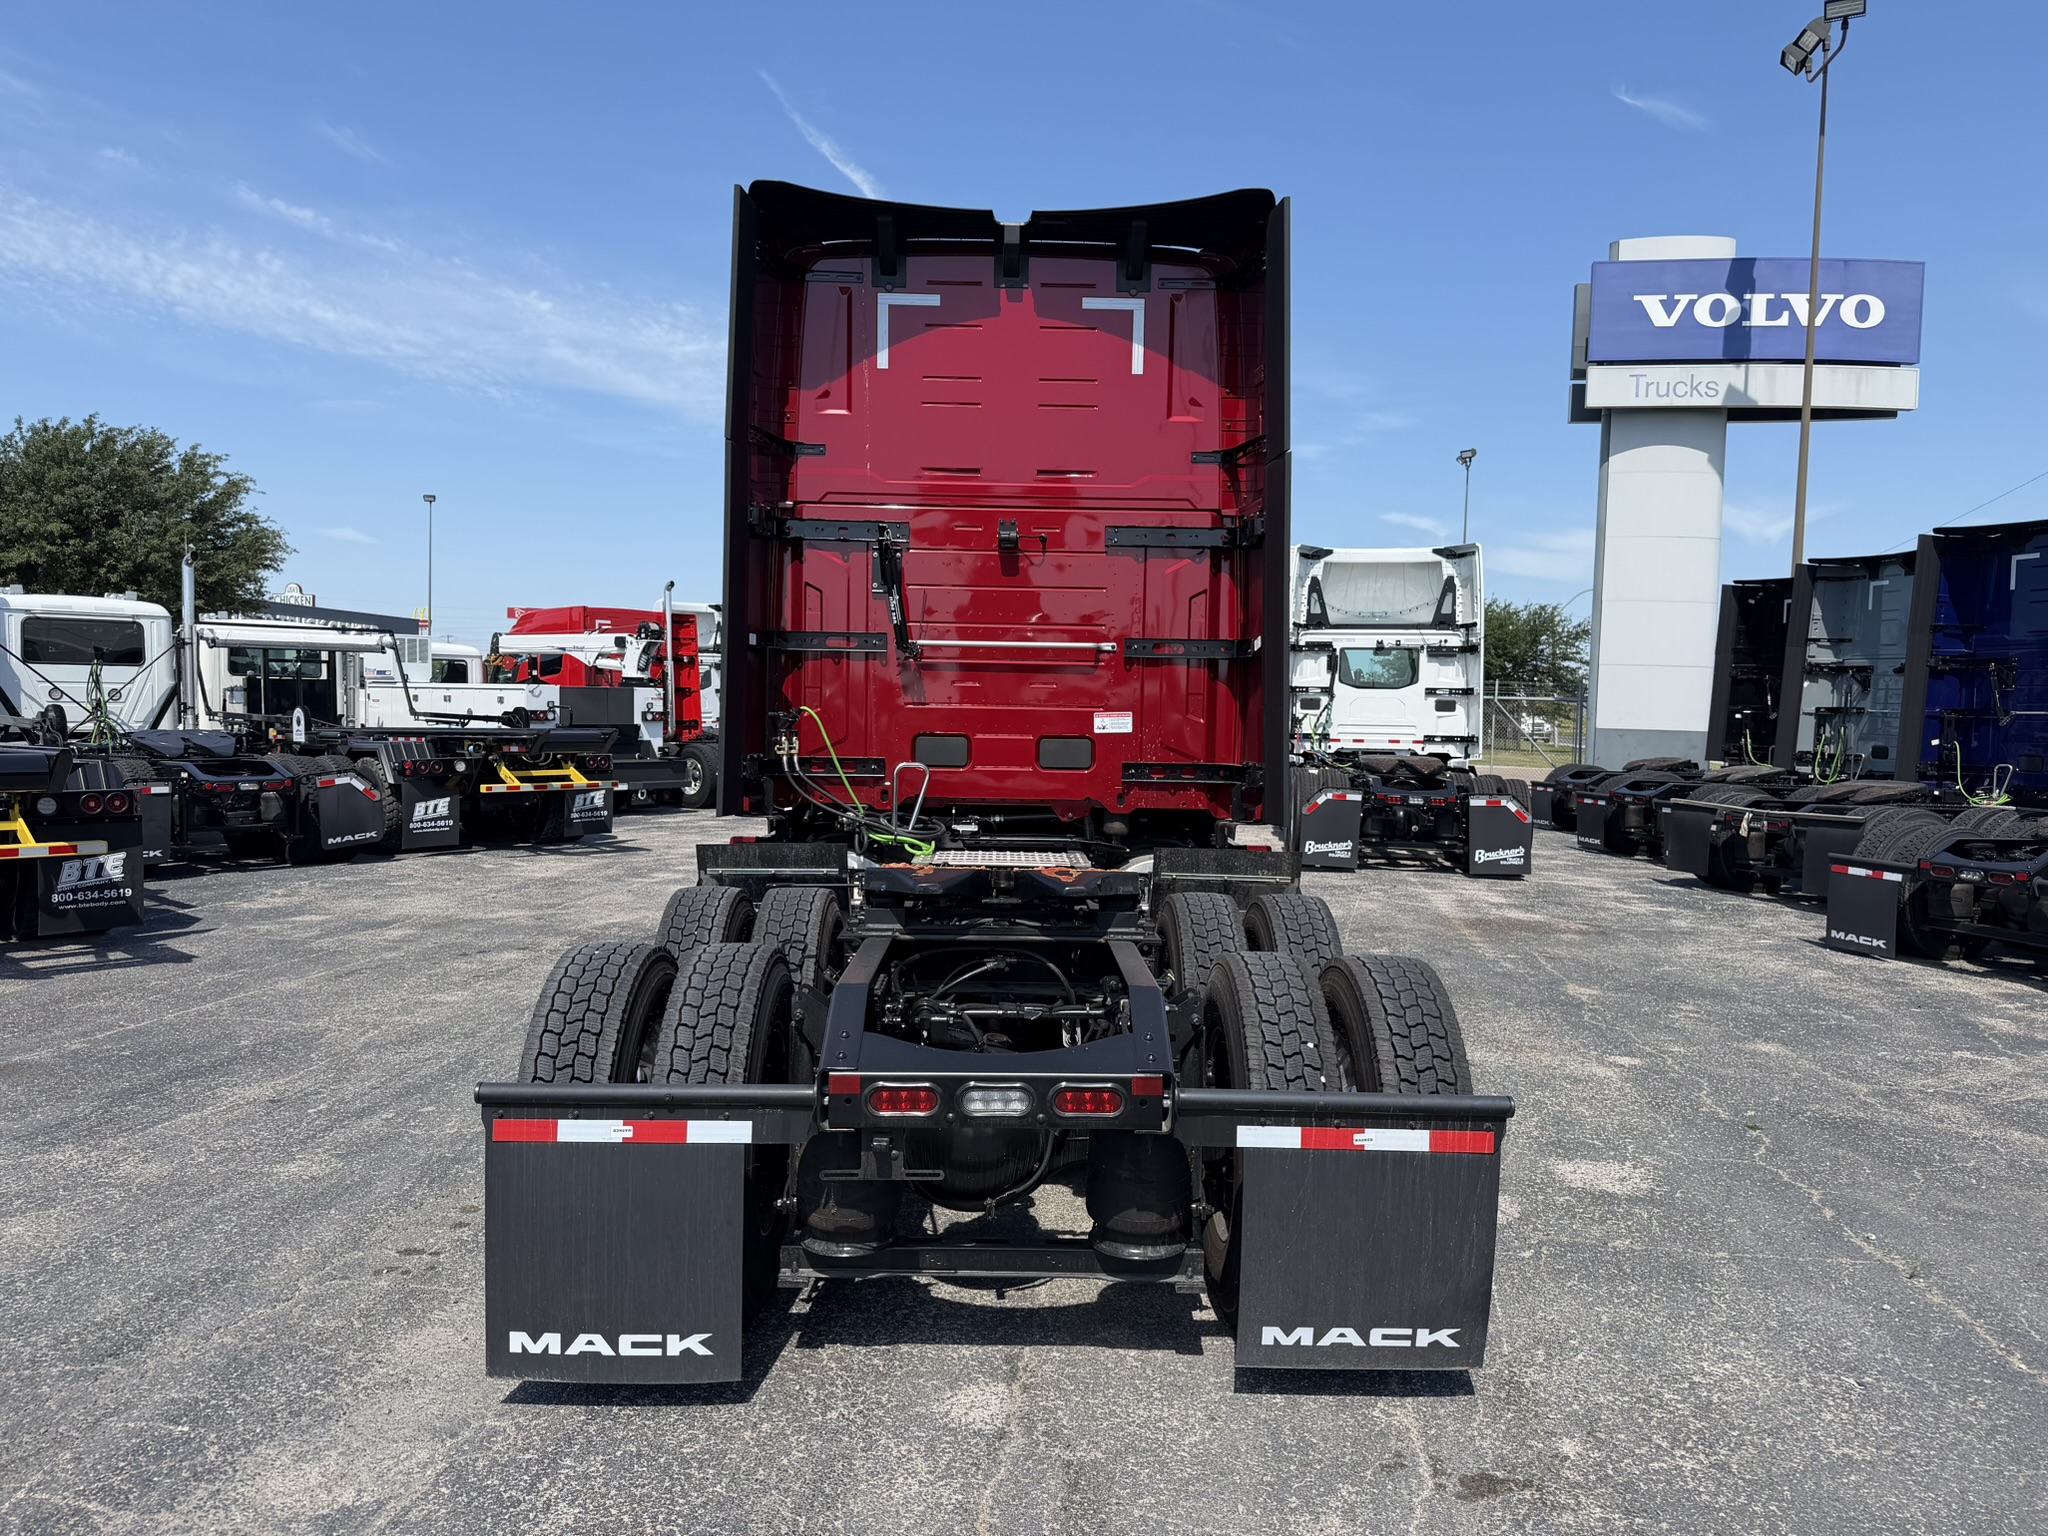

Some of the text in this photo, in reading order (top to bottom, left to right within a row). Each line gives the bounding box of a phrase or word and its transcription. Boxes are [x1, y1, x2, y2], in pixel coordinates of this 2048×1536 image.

[1633, 293, 1885, 329] VOLVO
[1629, 374, 1719, 398] Trucks
[274, 595, 312, 606] CHICKEN
[413, 797, 451, 816] BTE
[574, 789, 606, 806] BTE
[409, 819, 454, 829] 800-634-5619
[327, 830, 378, 845] MACK
[1578, 835, 1601, 845] MACK
[58, 852, 127, 885] BTE
[51, 888, 132, 903] 800-634-5619
[58, 900, 127, 910] www.btebody.com
[1830, 929, 1887, 949] MACK
[509, 1331, 714, 1356] MACK
[1261, 1326, 1461, 1348] MACK
